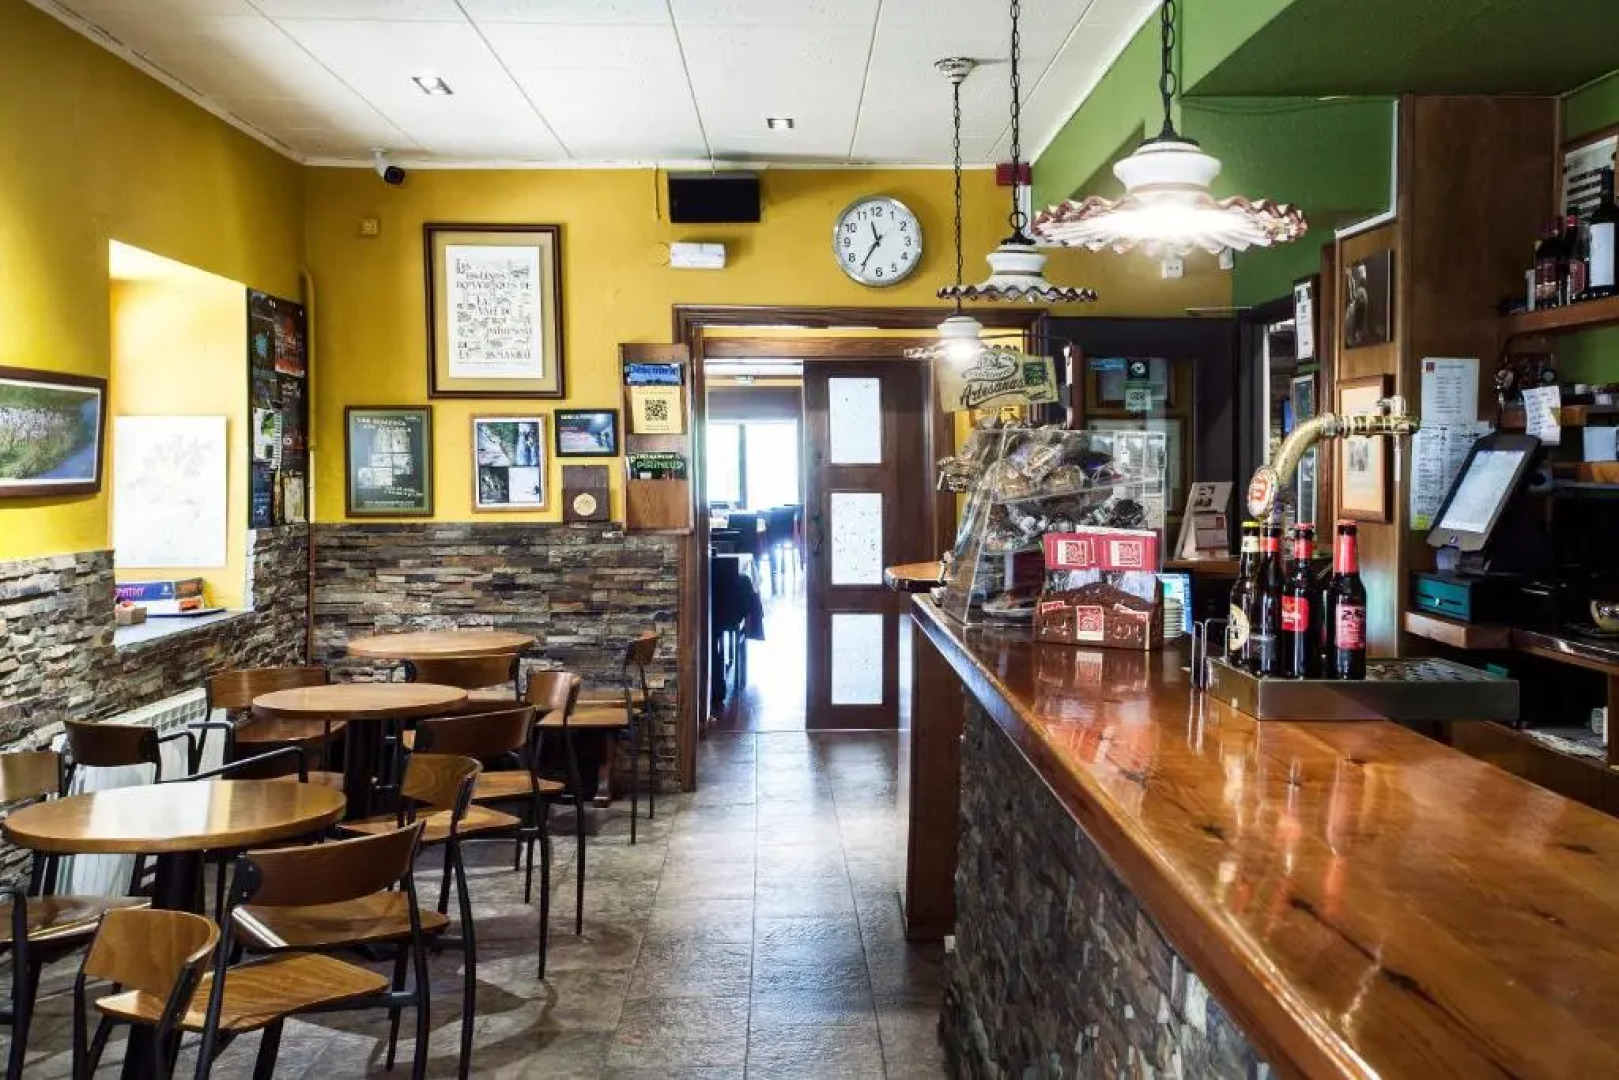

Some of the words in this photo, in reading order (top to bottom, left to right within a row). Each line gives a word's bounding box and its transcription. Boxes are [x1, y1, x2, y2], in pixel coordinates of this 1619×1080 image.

[857, 211, 867, 220] 11
[870, 206, 882, 217] 12
[890, 211, 895, 220] 1
[845, 223, 857, 233] 10
[899, 221, 907, 231] 2
[844, 237, 851, 247] 9
[904, 236, 911, 247] 3
[848, 253, 856, 262] 8
[901, 252, 908, 260] 4
[875, 267, 883, 277] 6
[891, 263, 897, 273] 5
